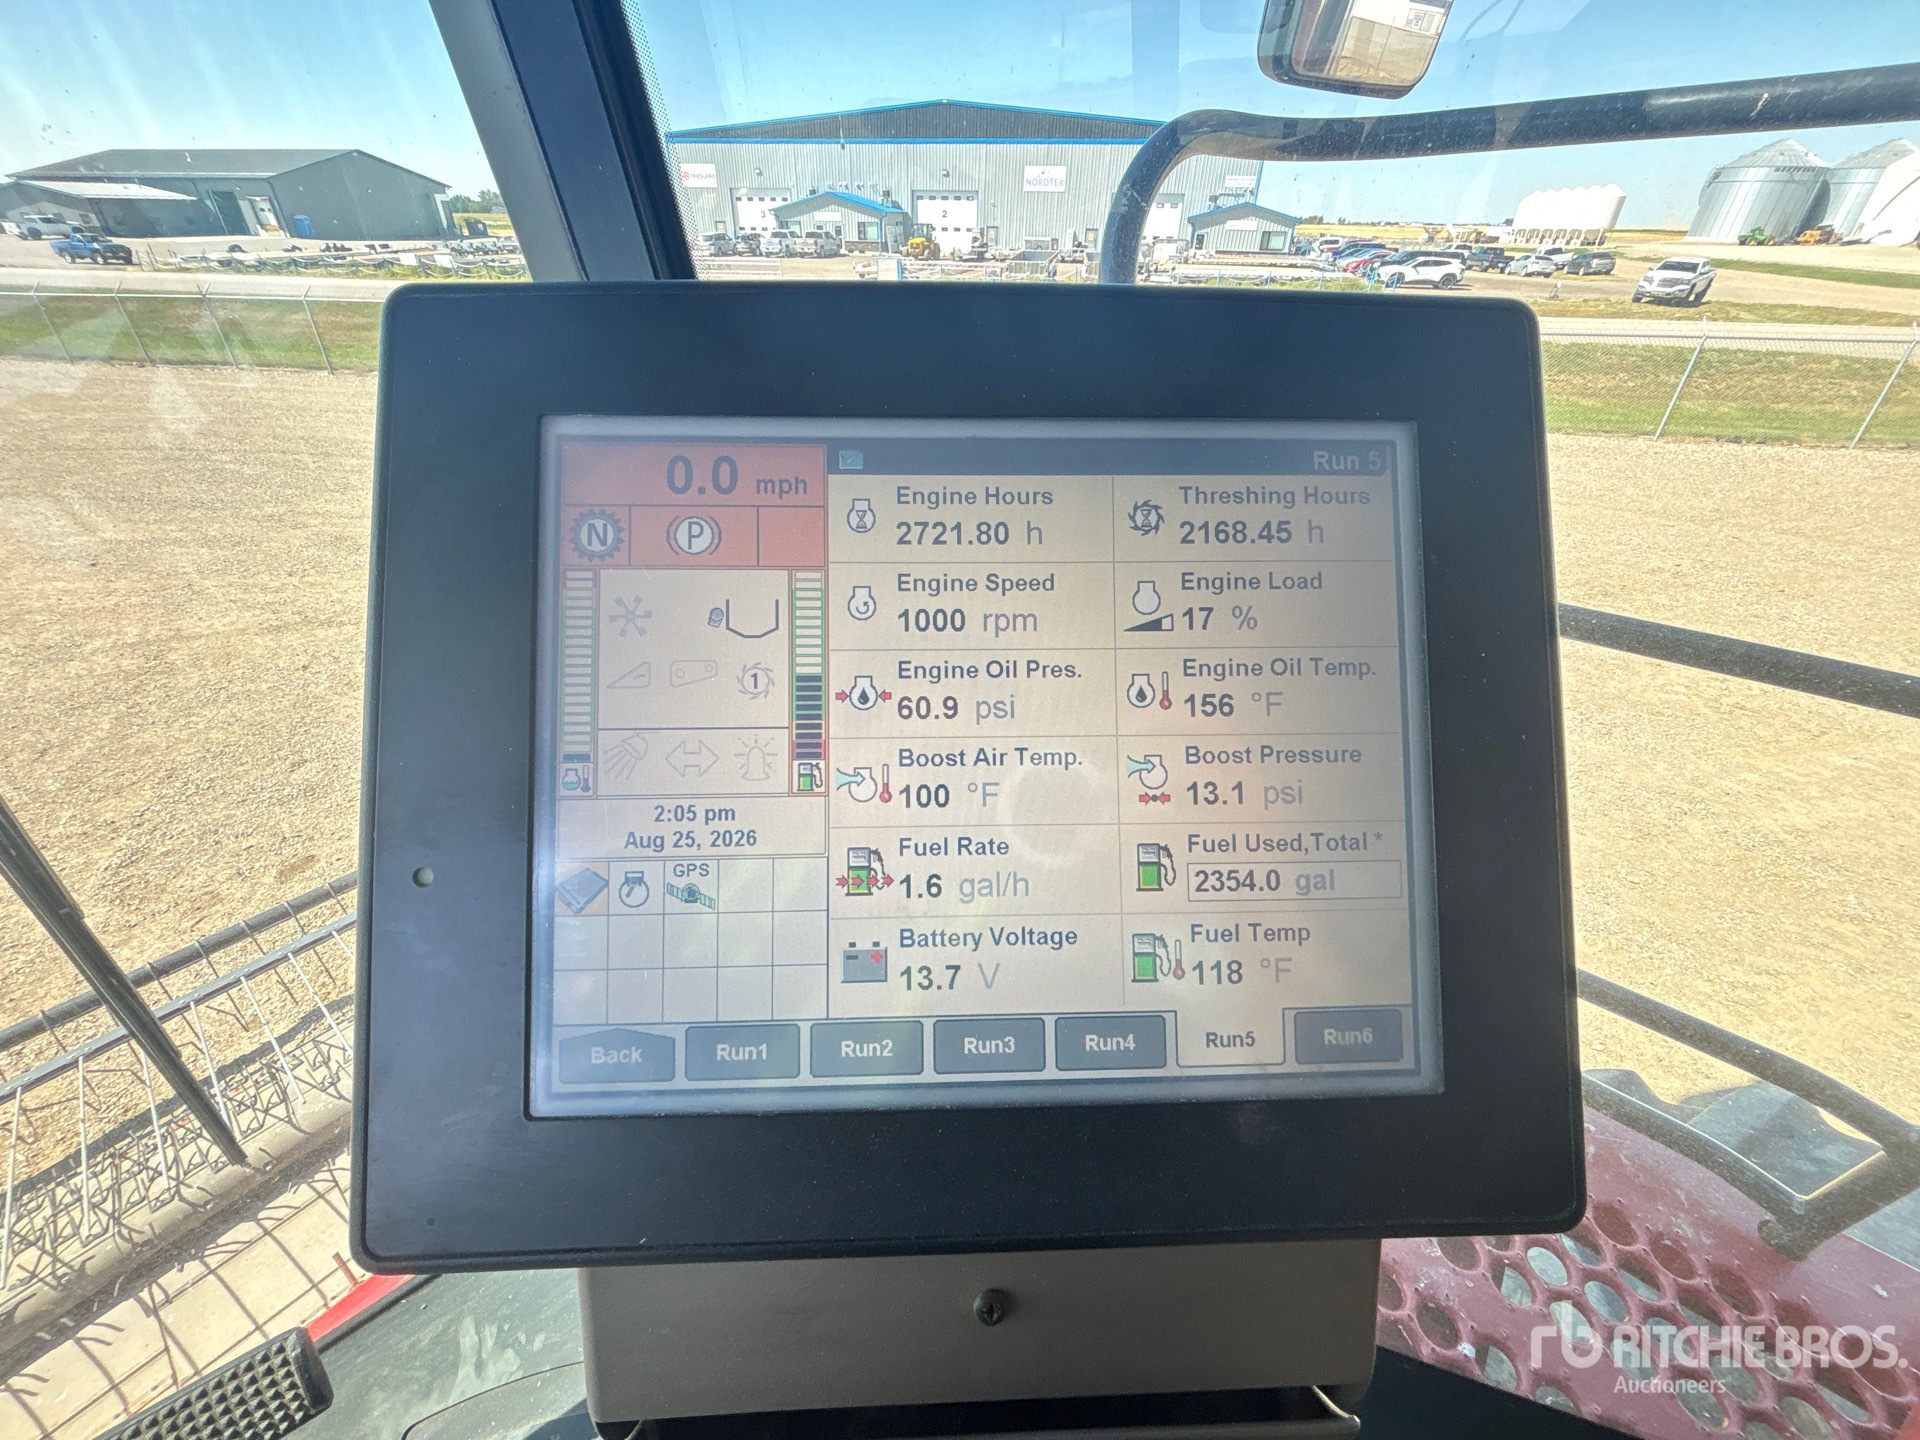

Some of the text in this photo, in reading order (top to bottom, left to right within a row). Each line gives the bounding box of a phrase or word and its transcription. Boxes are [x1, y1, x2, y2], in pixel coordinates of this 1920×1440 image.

[1025, 178, 1064, 187] NORDTEK
[760, 210, 766, 218] 3
[942, 210, 948, 218] 2
[1313, 450, 1382, 471] Run 5
[666, 455, 809, 500] 0.0 mph
[896, 486, 1054, 510] Engine Hours
[1178, 486, 1371, 509] Threshing Hours
[586, 522, 609, 548] N
[688, 521, 705, 550] P
[896, 521, 1043, 546] 2721.80 h
[1179, 520, 1325, 545] 2168.45 h
[896, 572, 1056, 597] Engine Speed
[1180, 571, 1324, 596] Engine Load
[897, 608, 1038, 639] 1000 rpm
[1182, 605, 1258, 631] 17 %
[898, 659, 1082, 684] Engine Oil Pres.
[1182, 656, 1377, 682] Engine Oil Temp.
[897, 694, 1016, 726] 60.9 psi
[1184, 692, 1235, 718] 156
[898, 746, 1083, 771] Boost Air Temp.
[1184, 744, 1362, 764] Boost Pressure
[899, 784, 950, 809] 100
[1186, 779, 1304, 811] 13.1 psi
[653, 804, 736, 826] 2:05 pm
[624, 829, 758, 852] Aug 25, 2026
[899, 836, 1010, 856] Fuel Rate
[1187, 834, 1237, 854] Fuel
[672, 863, 710, 878] GPS
[1194, 868, 1336, 896] 2354.0 gal
[899, 871, 1030, 904] 1.6 gal/h
[900, 926, 1078, 952] Battery Voltage
[1190, 922, 1312, 946] Fuel Temp
[900, 962, 1001, 991] 13.7 V
[1192, 959, 1244, 986] 118
[840, 1039, 894, 1058] Run2
[964, 1036, 1016, 1055] Run3
[1084, 1034, 1136, 1052] Run4
[1205, 1030, 1256, 1050] Run5
[1323, 1027, 1374, 1046] Run6
[590, 1046, 644, 1065] Back
[716, 1043, 768, 1062] Run1
